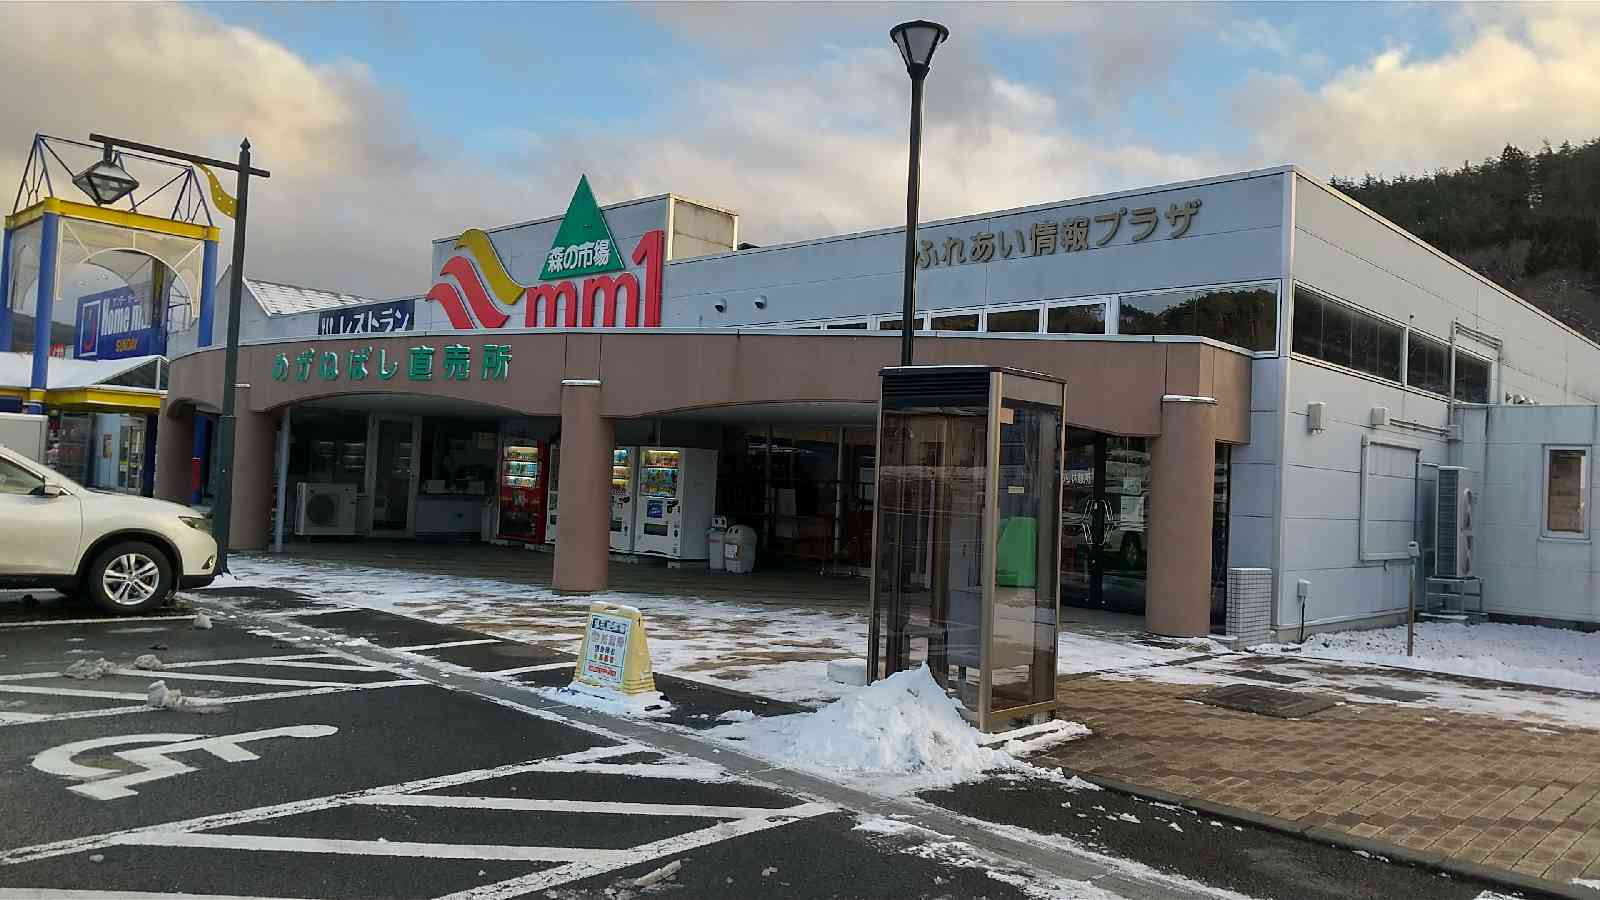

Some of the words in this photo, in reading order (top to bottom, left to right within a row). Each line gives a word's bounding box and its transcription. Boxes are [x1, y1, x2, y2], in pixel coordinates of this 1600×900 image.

[917, 199, 1202, 269] ふれあい情報プラザ
[548, 239, 610, 273] 森の市場
[101, 297, 131, 336] Home
[340, 308, 410, 334] レストラン
[272, 343, 513, 382] めがねばし直売所
